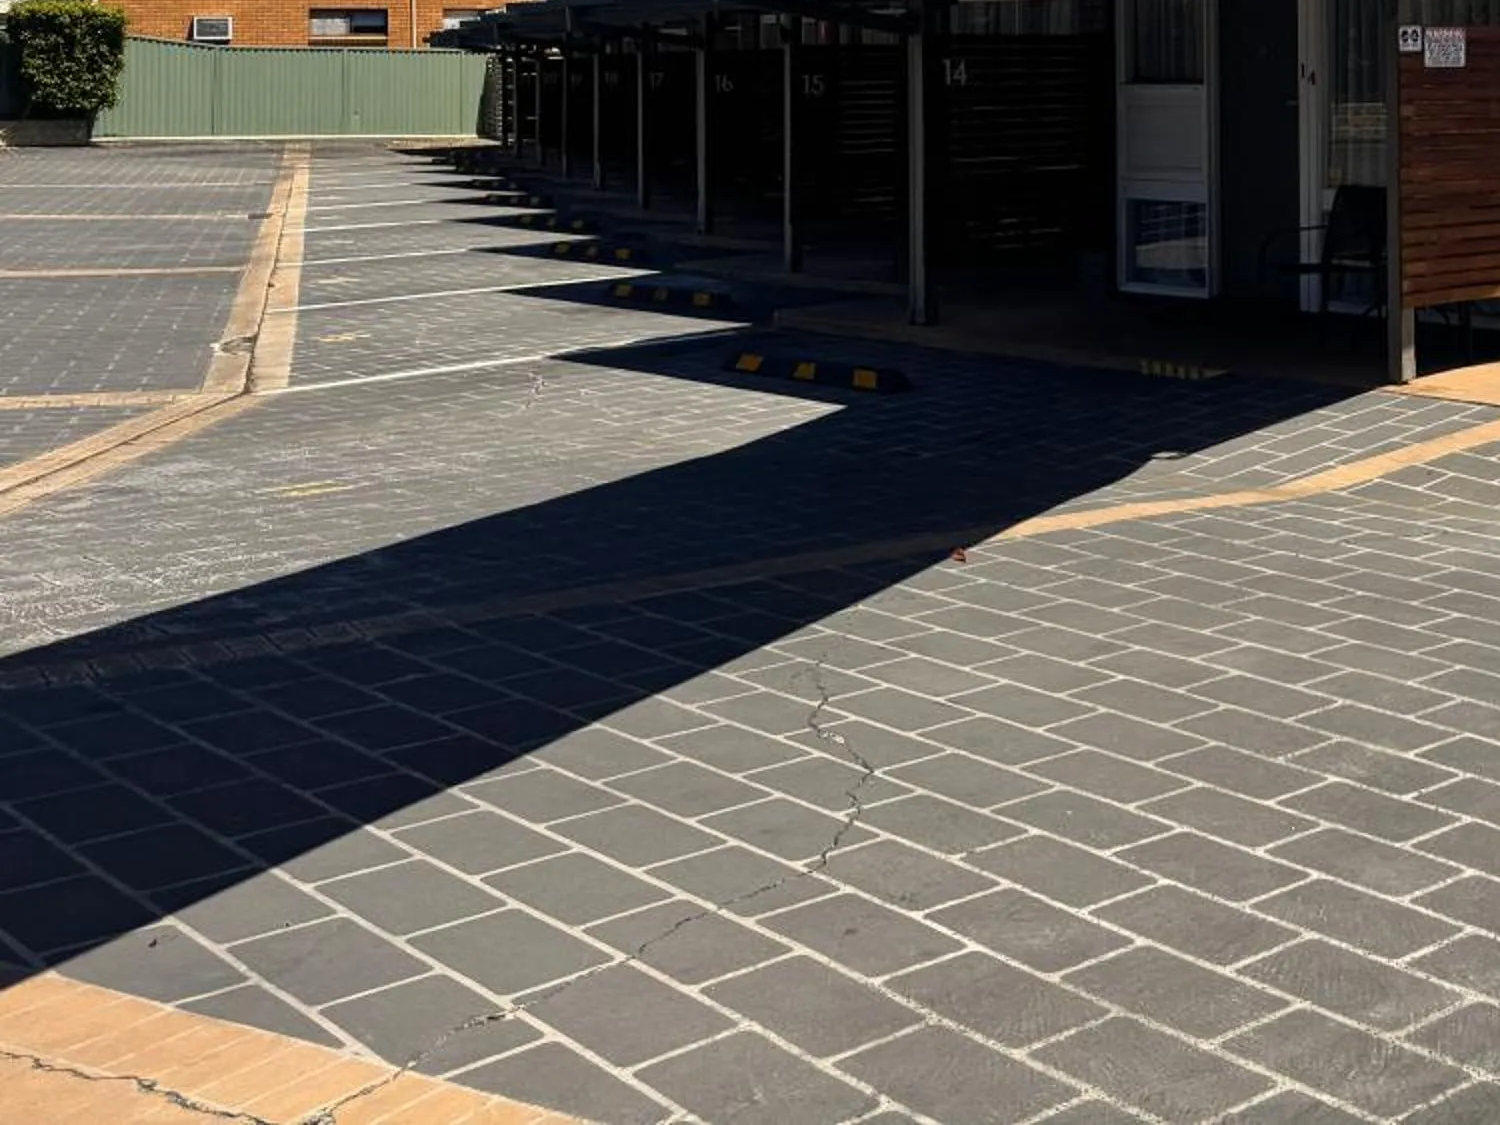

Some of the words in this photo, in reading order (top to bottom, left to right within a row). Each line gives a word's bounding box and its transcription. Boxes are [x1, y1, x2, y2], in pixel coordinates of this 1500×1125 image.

[647, 71, 666, 92] 17
[714, 72, 735, 94] 16
[941, 58, 968, 87] 14
[800, 73, 826, 96] 15
